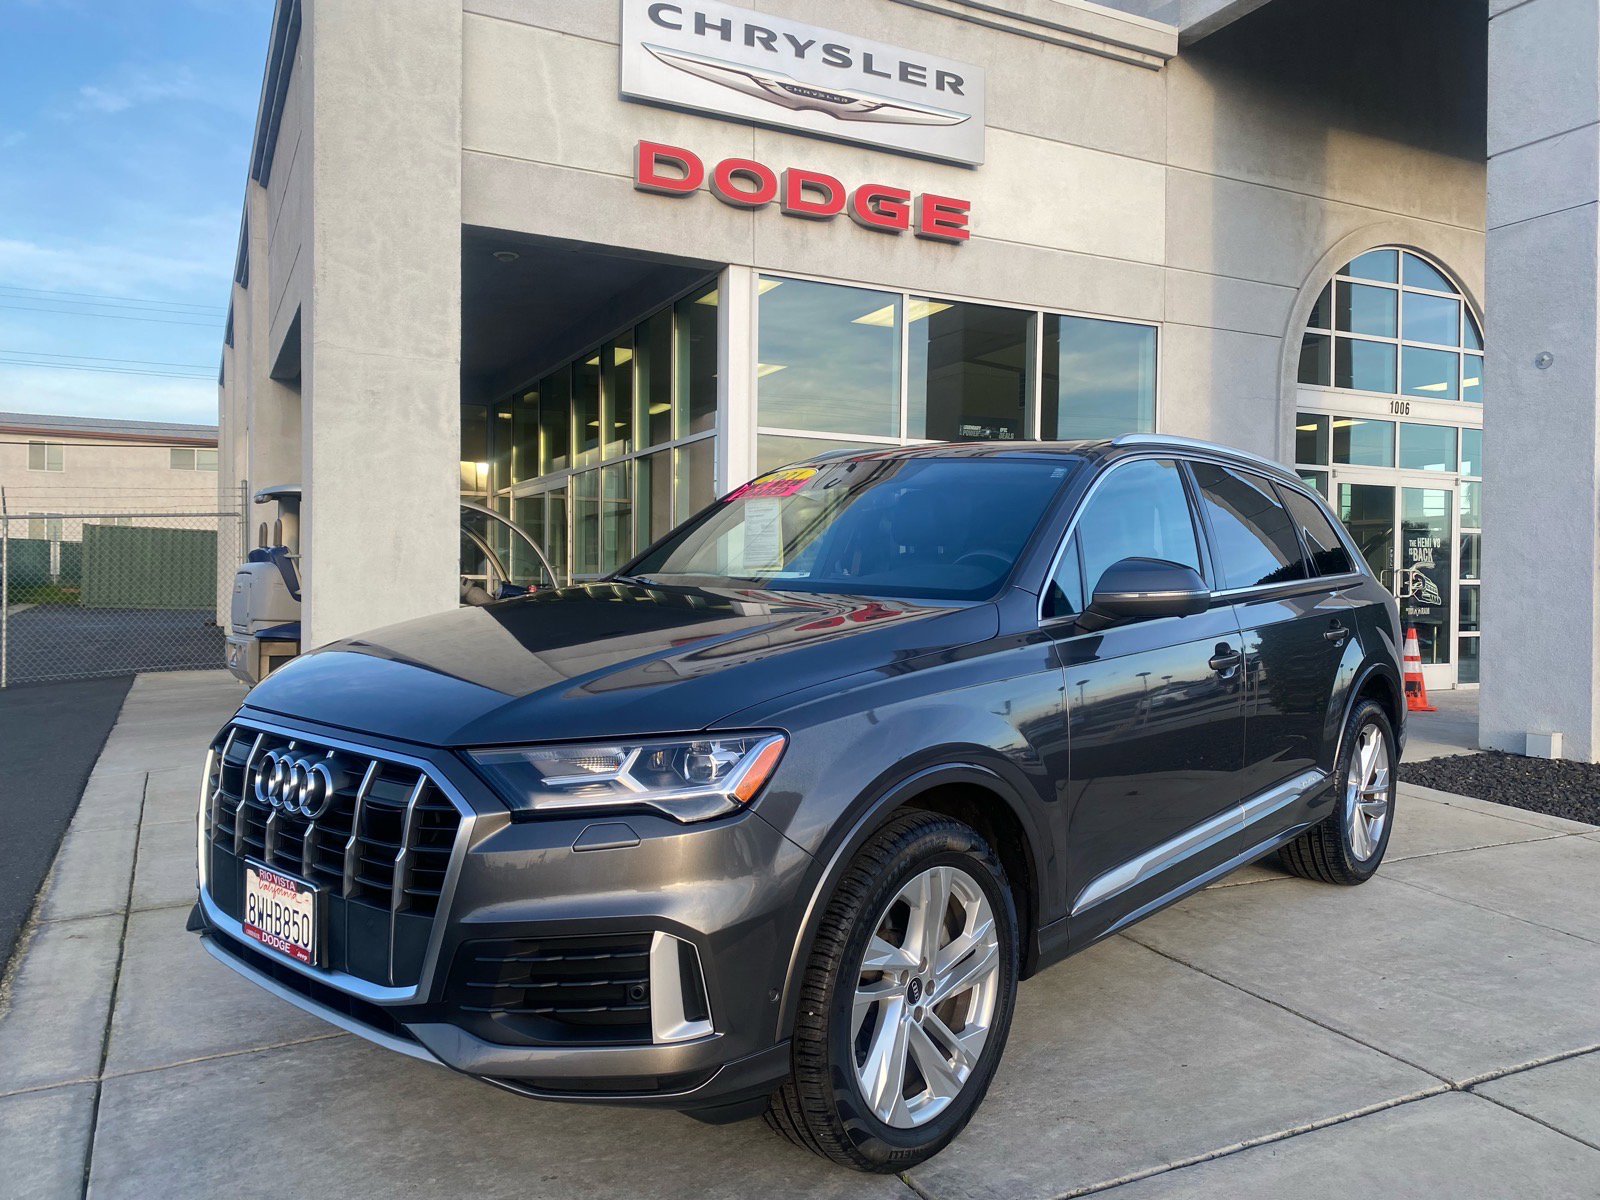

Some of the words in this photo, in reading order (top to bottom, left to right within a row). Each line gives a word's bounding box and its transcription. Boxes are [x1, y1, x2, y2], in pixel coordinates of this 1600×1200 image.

[647, 3, 965, 97] CHRYSLER
[634, 139, 971, 243] DODGE
[1390, 400, 1410, 415] 1006
[1409, 539, 1417, 547] THE
[1417, 537, 1432, 548] HEMI
[1413, 547, 1433, 562] BACK
[260, 870, 273, 882] RIO
[273, 875, 296, 891] VISTA
[249, 892, 310, 948] 8WHB850
[262, 932, 291, 953] DODGE
